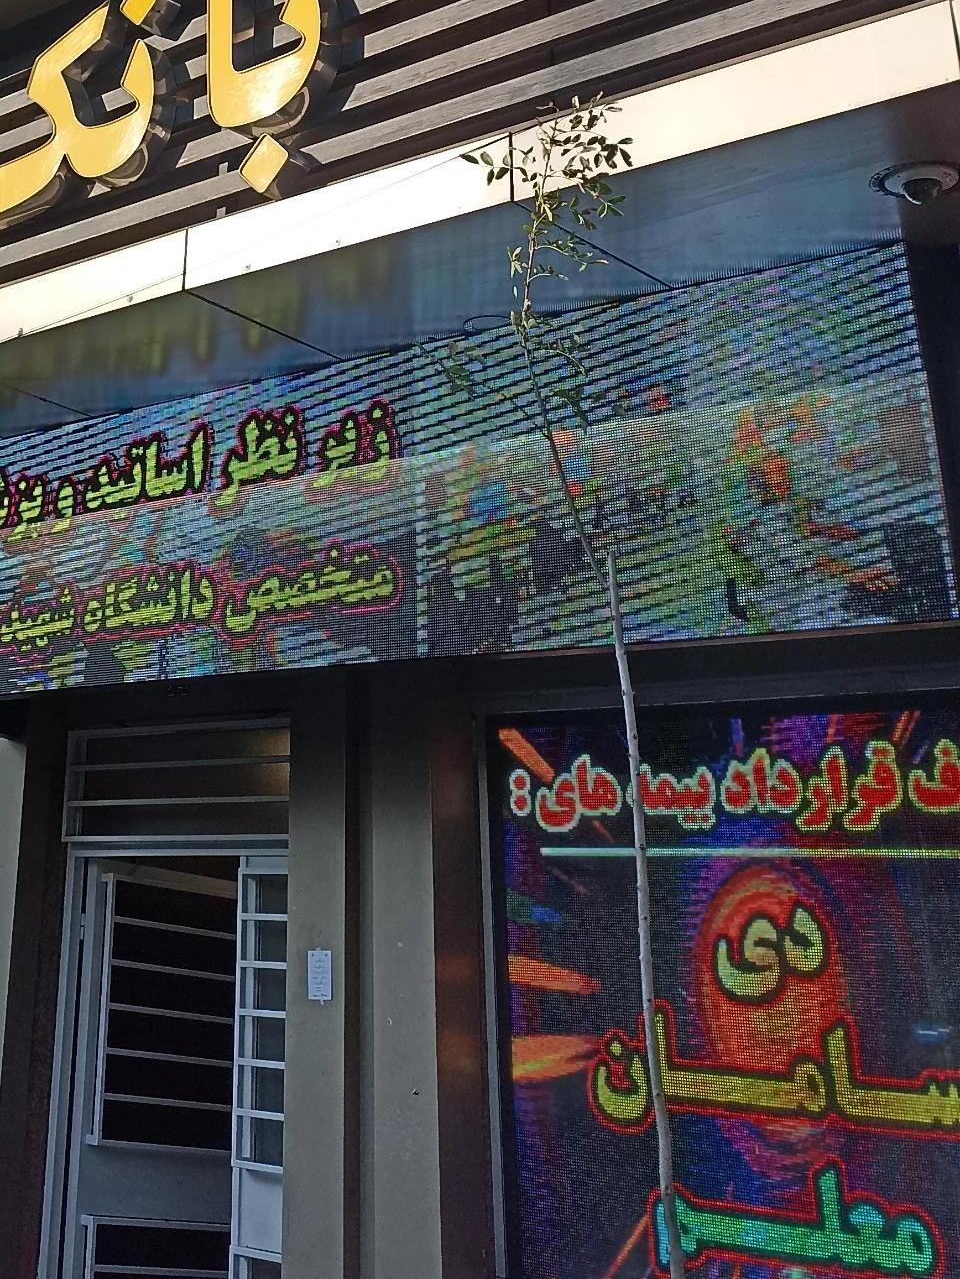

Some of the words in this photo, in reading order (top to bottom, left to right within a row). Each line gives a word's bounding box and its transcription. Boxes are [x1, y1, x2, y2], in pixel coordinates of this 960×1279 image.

[214, 412, 298, 508] نظر
[311, 407, 391, 489] زیر
[0, 586, 76, 653] شهید
[83, 569, 214, 633] دانشگاه
[225, 548, 395, 631] متخصص
[720, 740, 903, 832] قرارداد
[715, 906, 826, 999] دی
